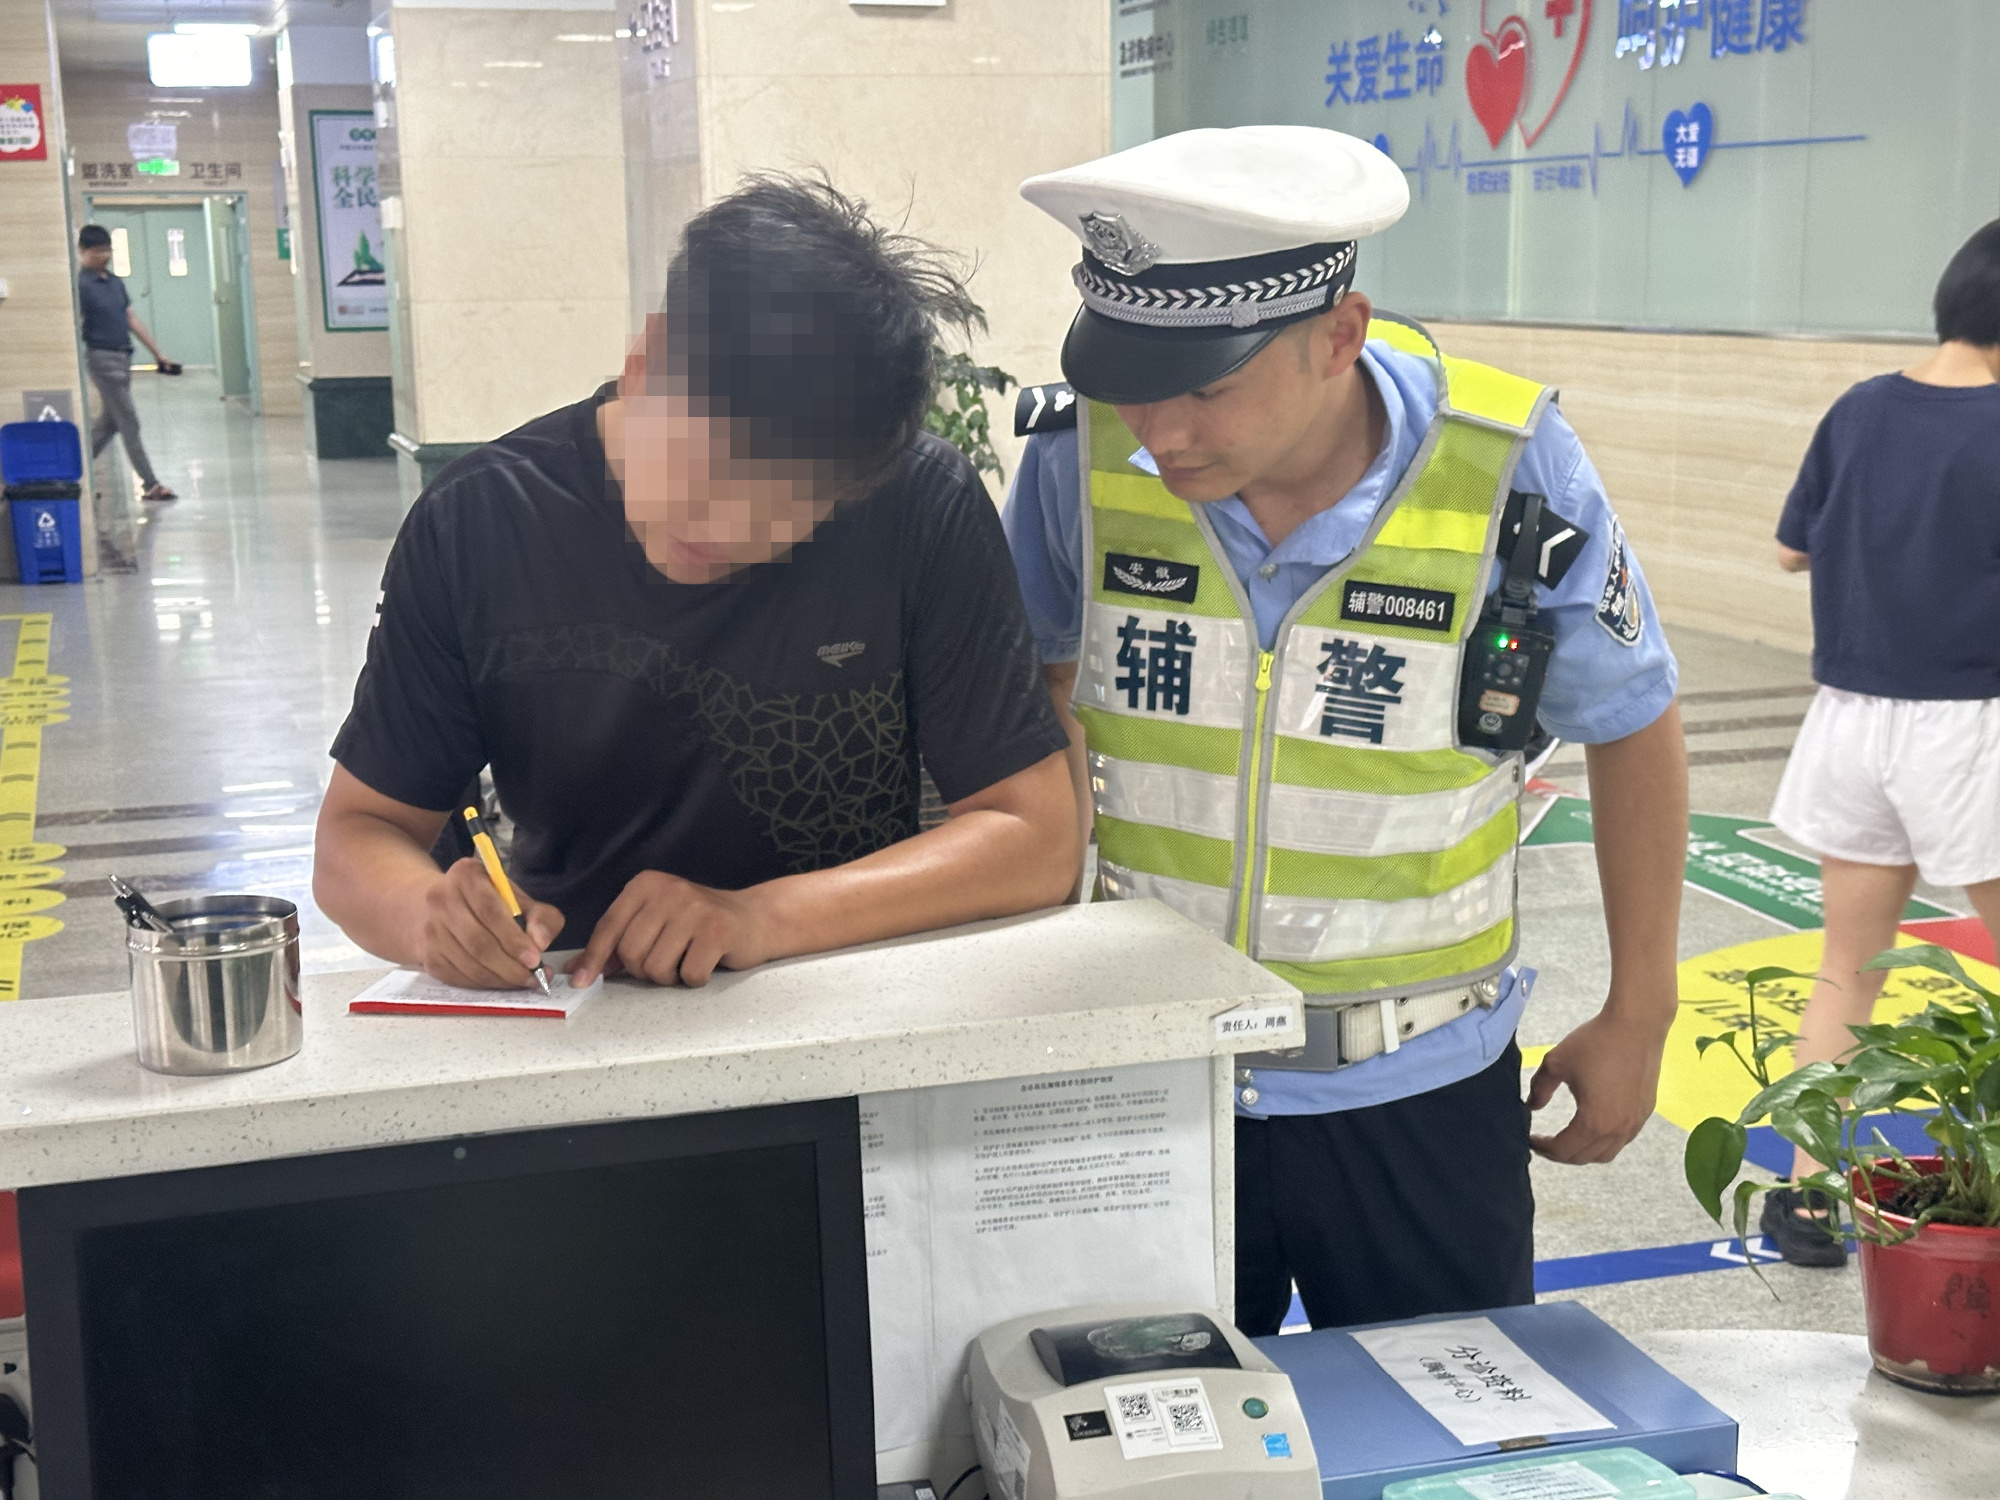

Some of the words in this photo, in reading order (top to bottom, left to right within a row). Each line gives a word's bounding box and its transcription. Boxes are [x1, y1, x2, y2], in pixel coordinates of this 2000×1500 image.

[1325, 24, 1445, 108] 关爱生命
[1674, 122, 1700, 144] 大爱
[190, 162, 242, 180] 卫生间
[334, 187, 378, 209] 全民
[1348, 590, 1446, 622] 辅警008461
[1115, 615, 1197, 716] 辅
[1315, 637, 1406, 745] 警
